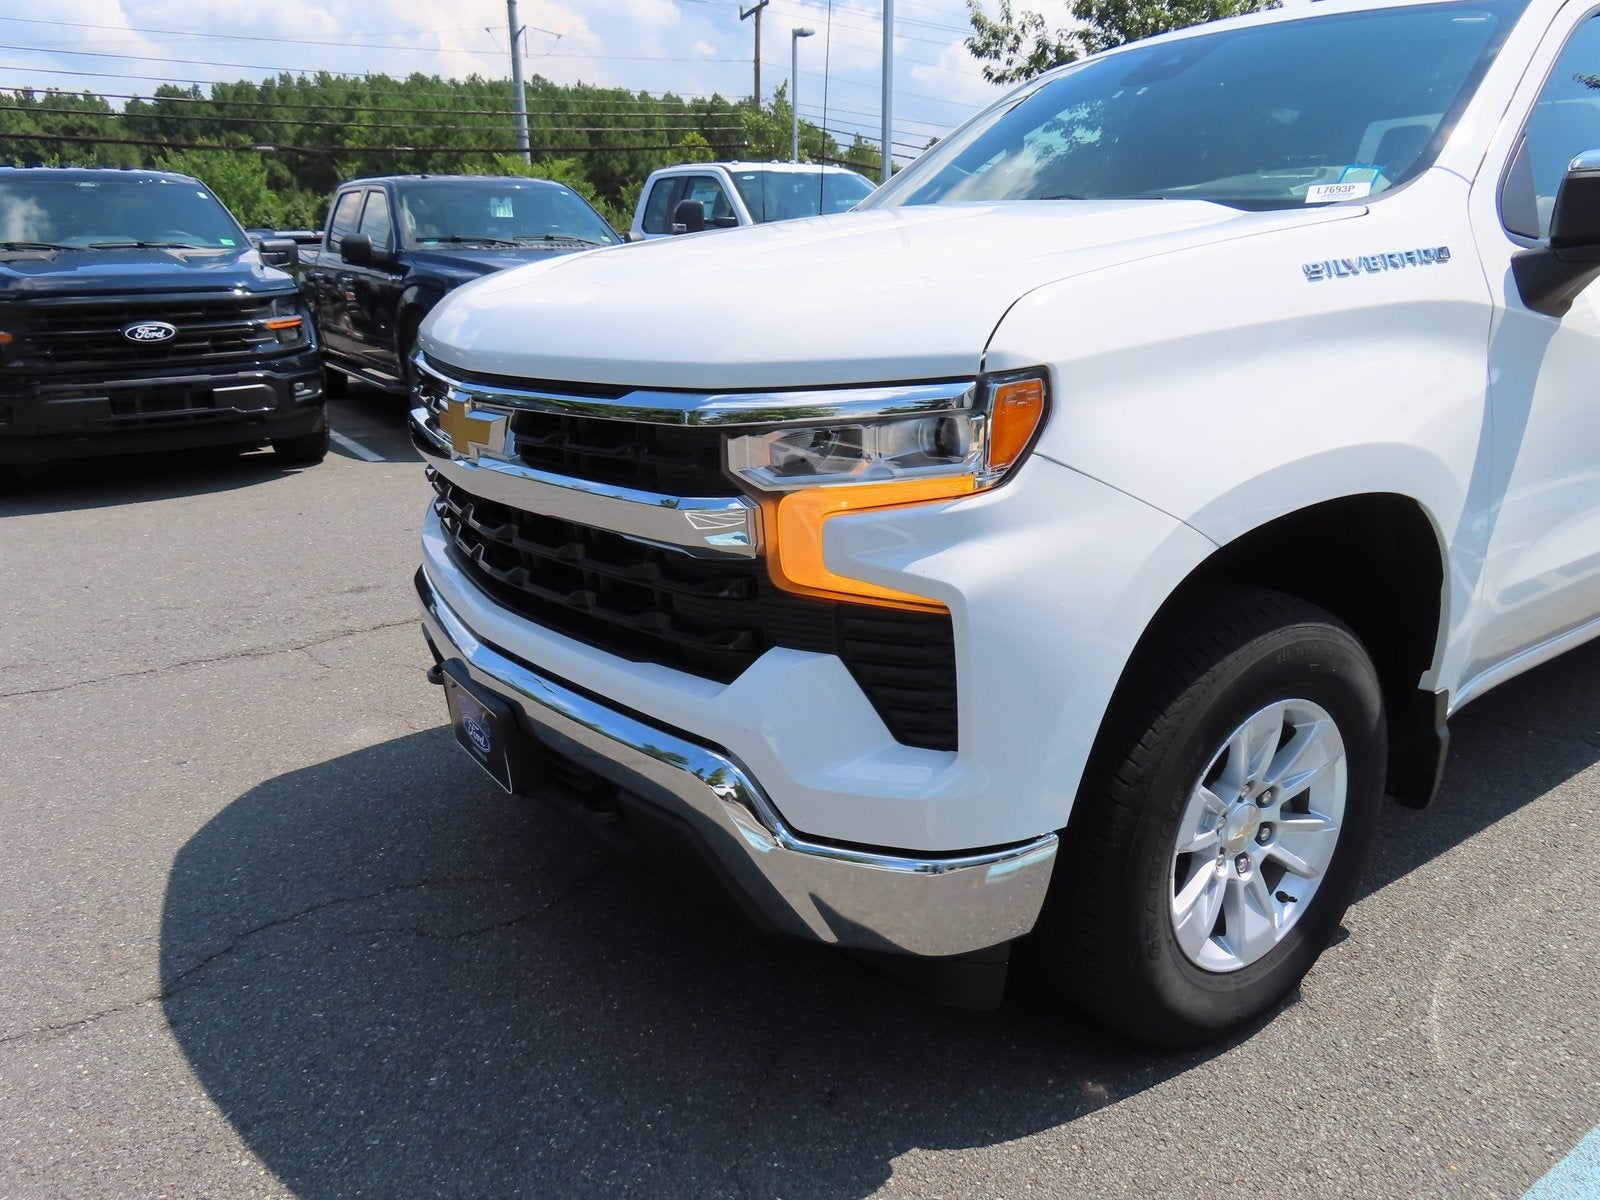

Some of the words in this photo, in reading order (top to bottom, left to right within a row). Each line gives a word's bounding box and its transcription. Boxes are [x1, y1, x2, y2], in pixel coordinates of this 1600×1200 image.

[1316, 185, 1356, 195] L7693P
[1302, 246, 1451, 282] SILVERADO
[135, 326, 166, 339] Ford
[467, 719, 487, 748] Ford
